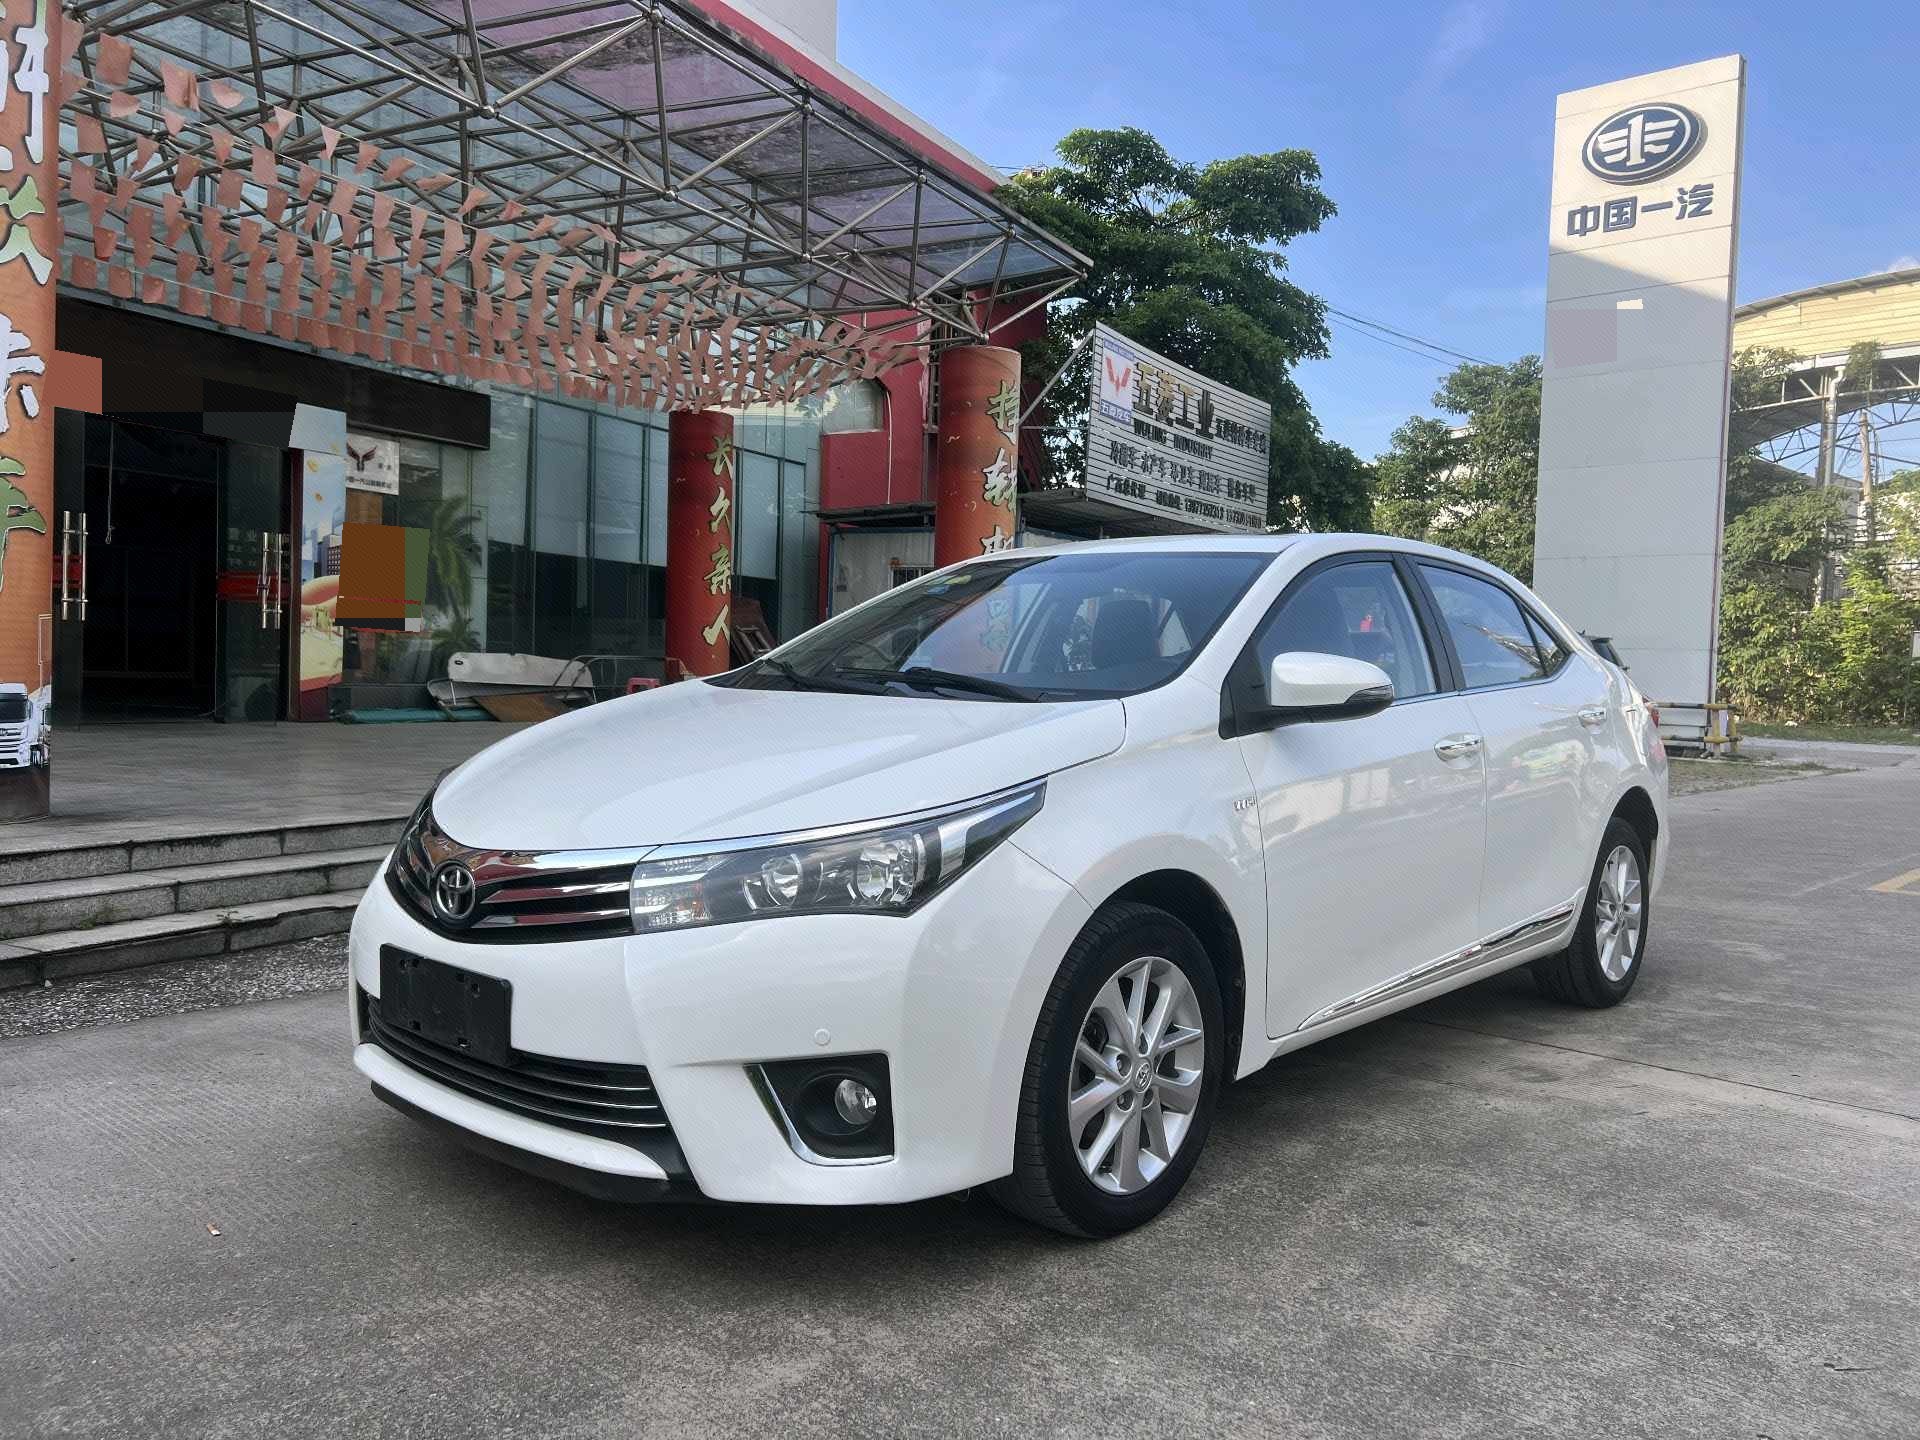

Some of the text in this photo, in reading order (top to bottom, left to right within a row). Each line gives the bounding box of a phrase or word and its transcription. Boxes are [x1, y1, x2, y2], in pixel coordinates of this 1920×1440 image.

[1567, 183, 1714, 237] 中国一汽
[1132, 362, 1215, 439] 五菱工业
